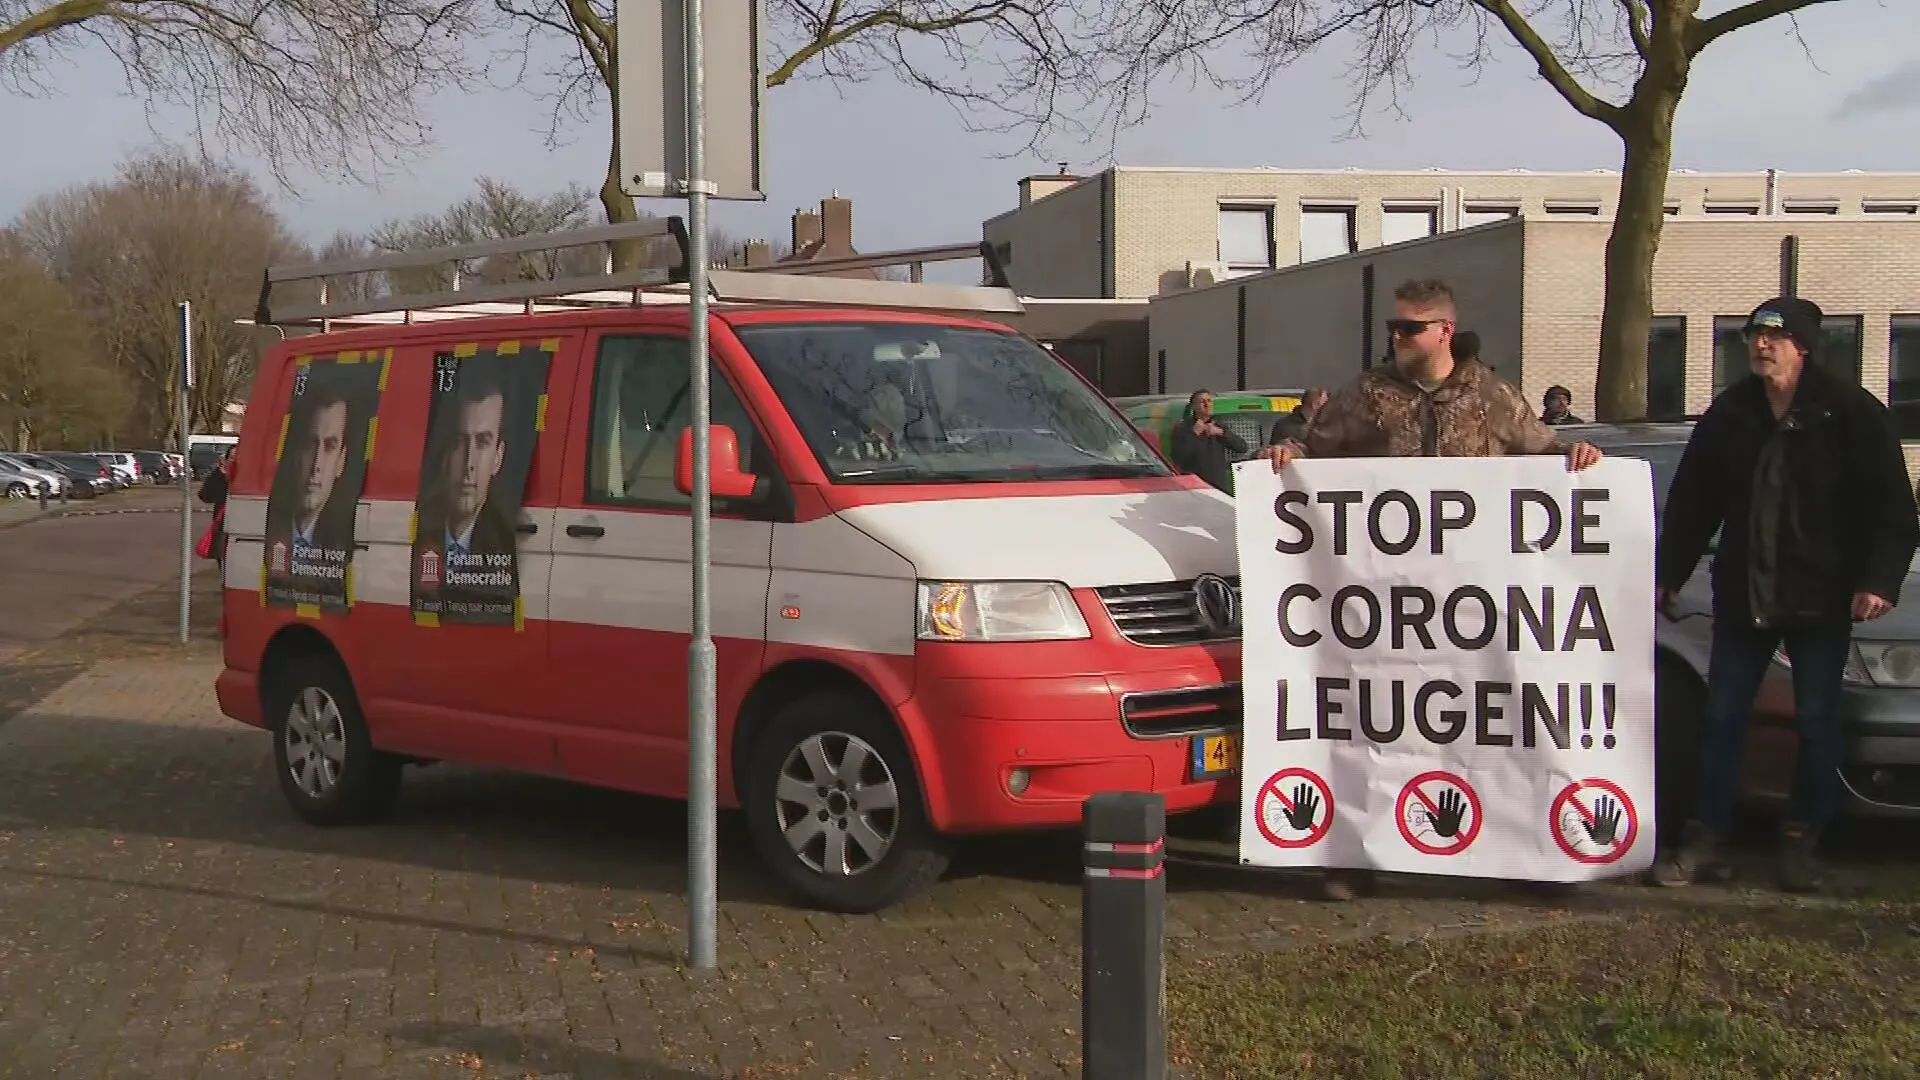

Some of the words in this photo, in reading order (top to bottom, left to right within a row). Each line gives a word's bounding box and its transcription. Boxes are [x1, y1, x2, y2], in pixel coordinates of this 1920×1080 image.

[294, 376, 308, 397] 13
[437, 369, 456, 392] 13
[1275, 489, 1476, 556] STOP
[1510, 488, 1610, 554] DE
[292, 544, 323, 560] Forum
[324, 547, 346, 562] voor
[447, 550, 483, 566] Forum
[485, 553, 512, 567] voor
[291, 560, 345, 580] Democratie
[446, 569, 512, 586] Democratie
[1277, 583, 1615, 652] CORONA
[1276, 676, 1617, 750] LEUGEN!!
